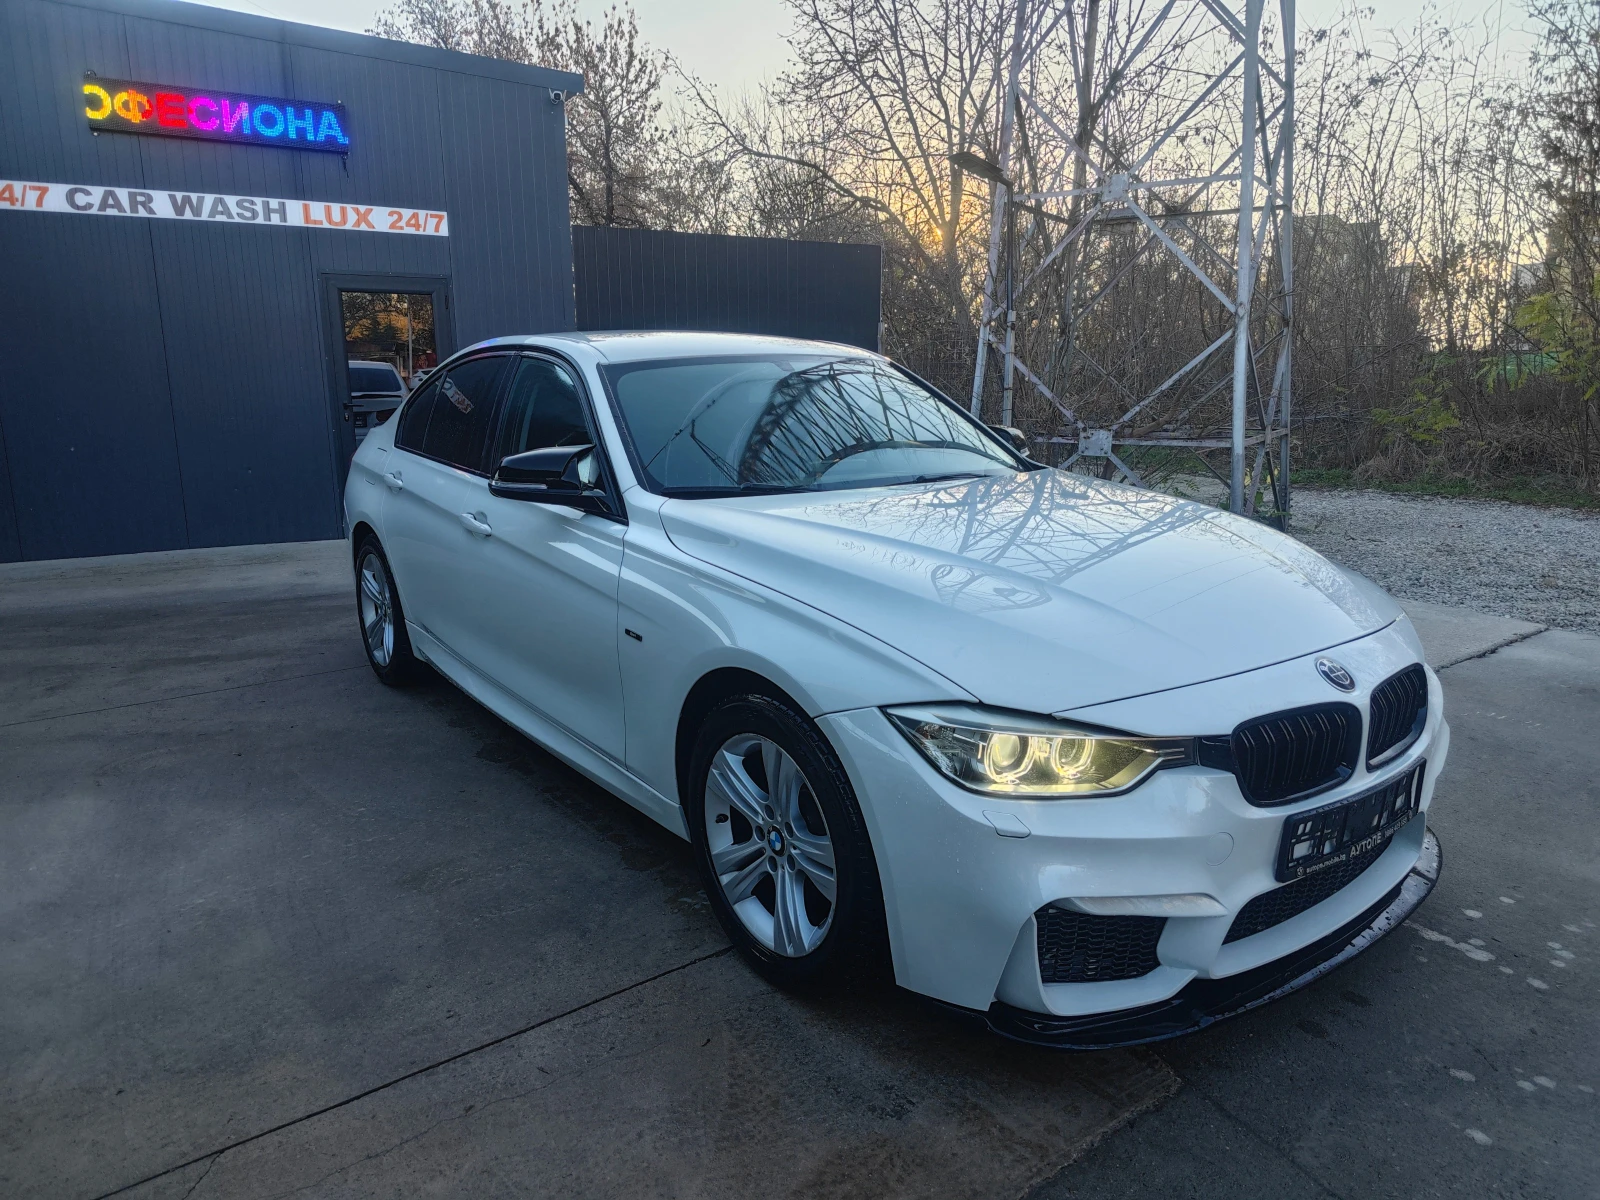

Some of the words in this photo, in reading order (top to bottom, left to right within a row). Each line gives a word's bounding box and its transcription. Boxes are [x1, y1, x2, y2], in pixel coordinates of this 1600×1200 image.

[83, 84, 348, 144] ОФЕСИОНА
[0, 183, 49, 208] 4/7
[65, 187, 157, 215] CAR
[167, 193, 288, 223] WASH
[302, 203, 376, 230] LUX
[388, 210, 445, 233] 24/7
